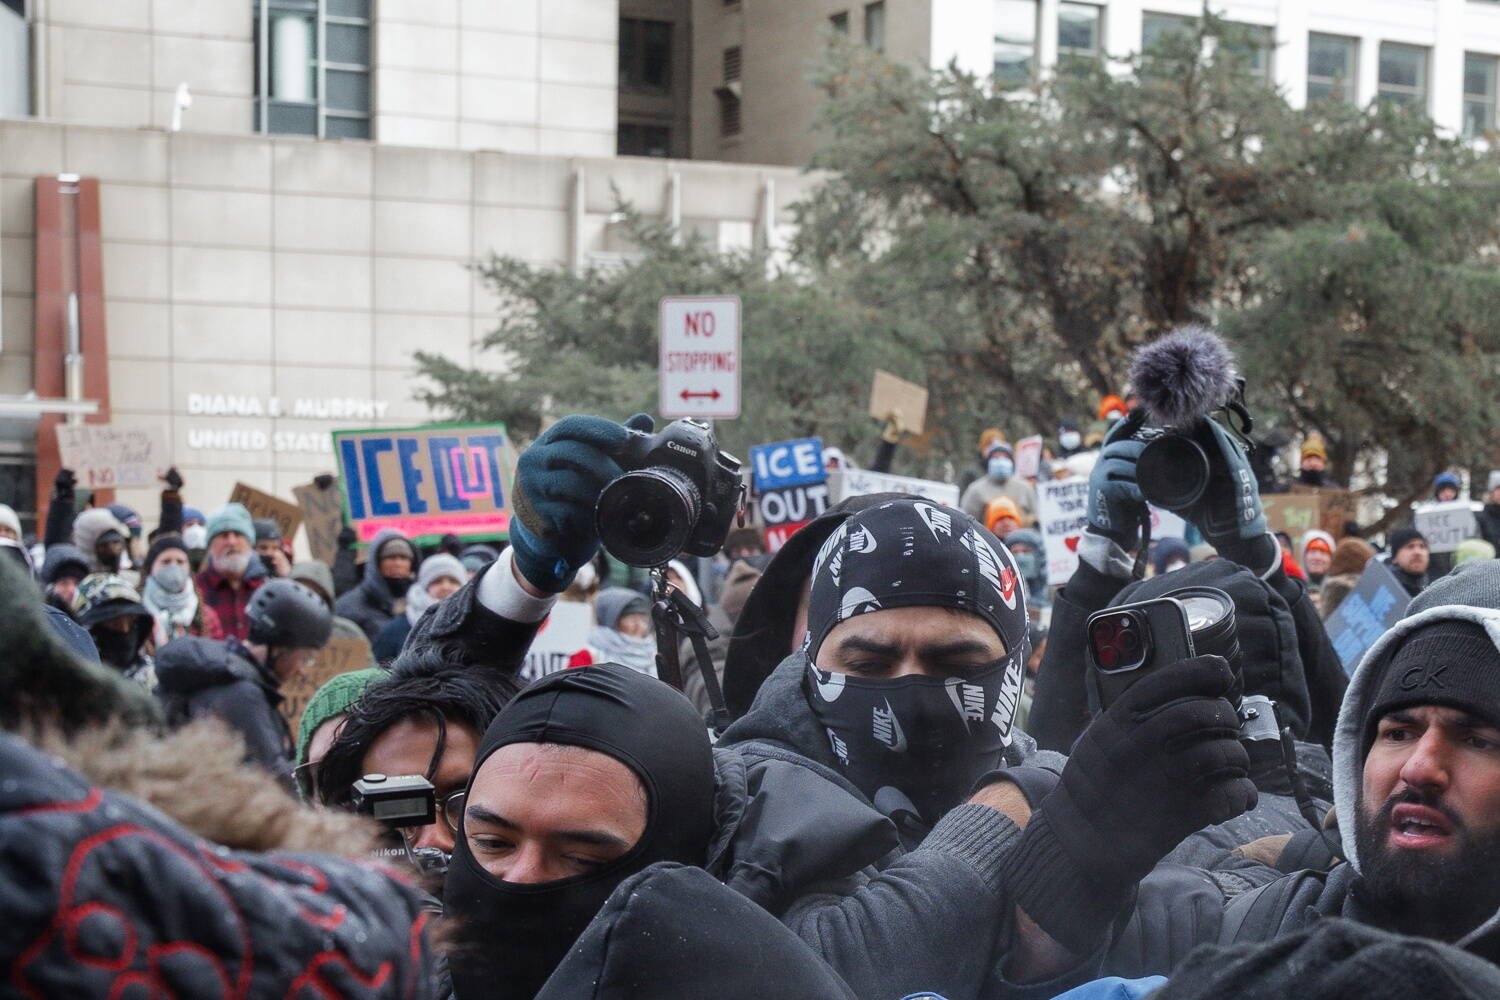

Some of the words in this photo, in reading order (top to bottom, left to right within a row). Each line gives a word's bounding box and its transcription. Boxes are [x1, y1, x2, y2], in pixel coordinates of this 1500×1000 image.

[684, 311, 717, 337] NO
[665, 351, 736, 373] STOPPING
[188, 393, 264, 416] DIANA
[292, 397, 389, 418] MURPHY
[187, 430, 267, 451] UNITED
[273, 432, 333, 454] STATE
[666, 440, 698, 458] Canon
[756, 443, 819, 479] ICE
[341, 438, 428, 519] ICE
[428, 435, 504, 511] OUT
[1046, 482, 1089, 498] PROTEC
[760, 486, 828, 524] OUT
[930, 508, 952, 537] NIKE
[1401, 664, 1448, 692] CK
[962, 684, 984, 722] NIKE
[990, 660, 1020, 734] NIKE
[872, 706, 892, 745] NIKE
[371, 848, 405, 857] Nikon
